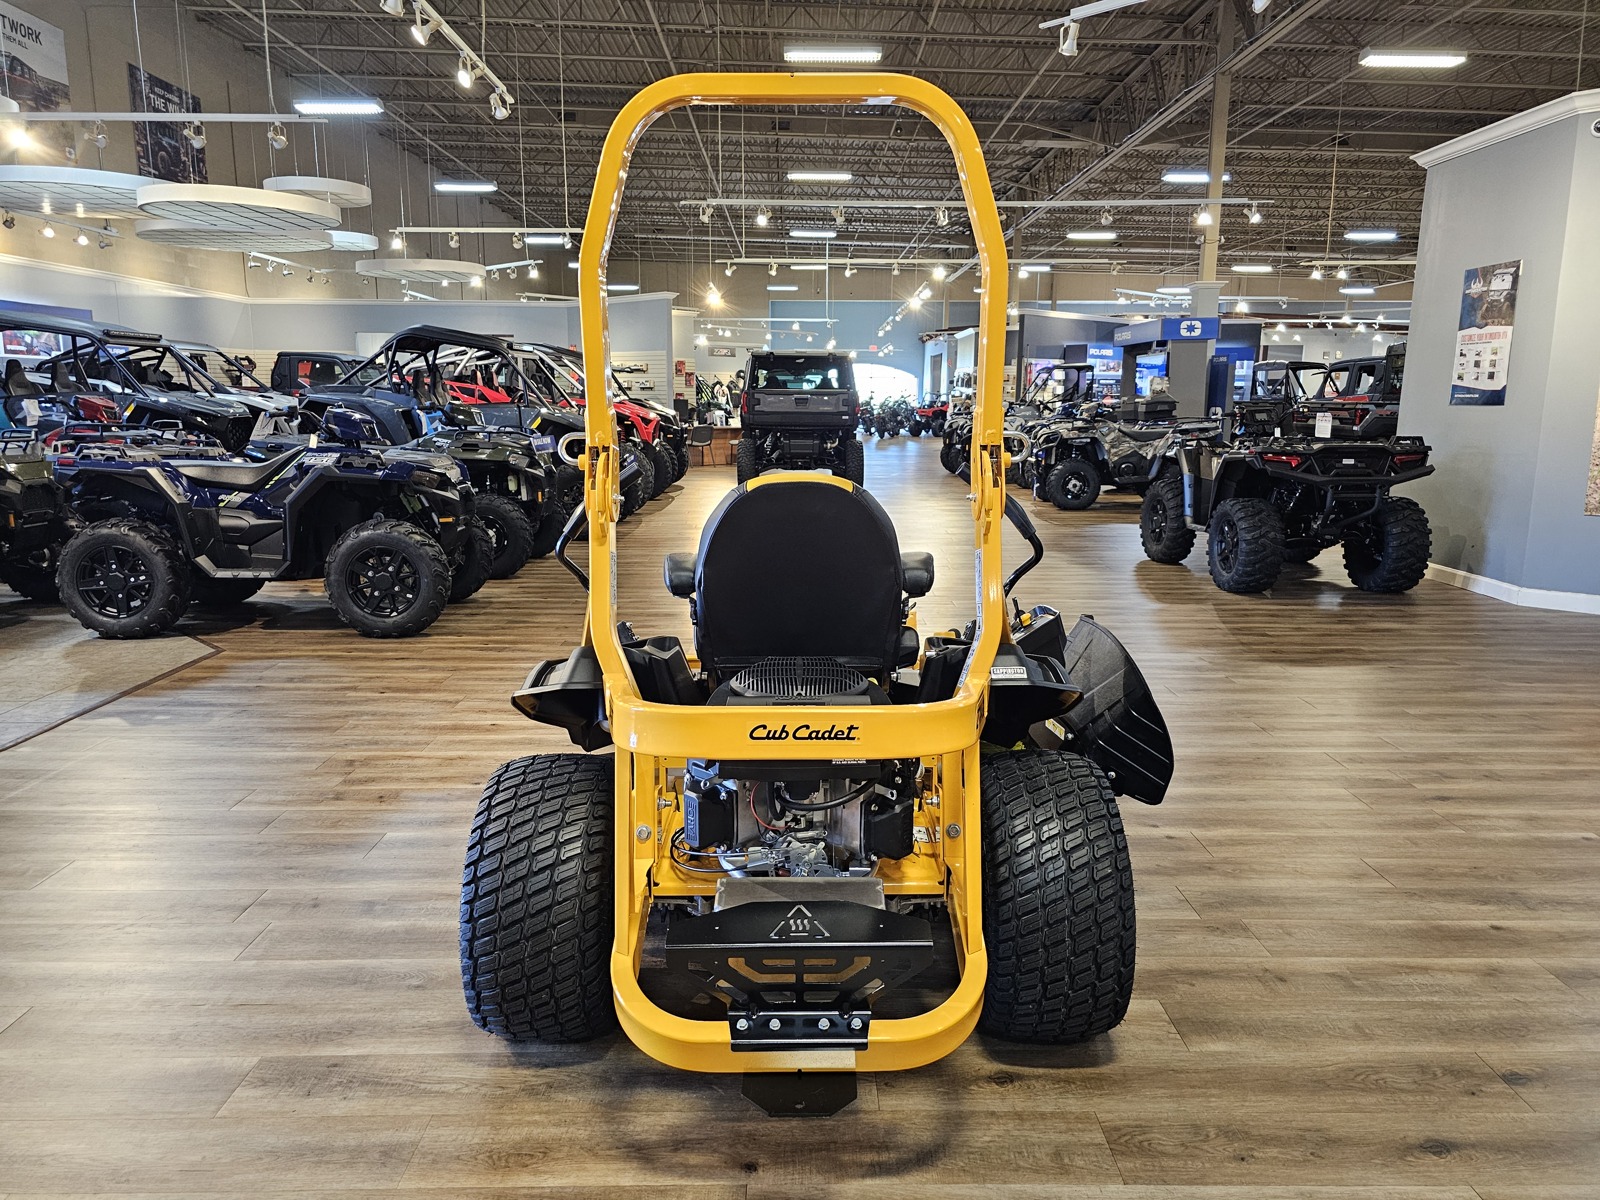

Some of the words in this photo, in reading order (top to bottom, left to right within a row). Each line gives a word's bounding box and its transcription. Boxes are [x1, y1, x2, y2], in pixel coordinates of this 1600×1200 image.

[149, 93, 167, 112] THE
[1114, 331, 1132, 341] POLARIS
[1089, 348, 1114, 357] POLARIS
[993, 667, 1025, 675] SAPPINGTON
[748, 724, 790, 741] Cub
[791, 724, 860, 741] Cadet
